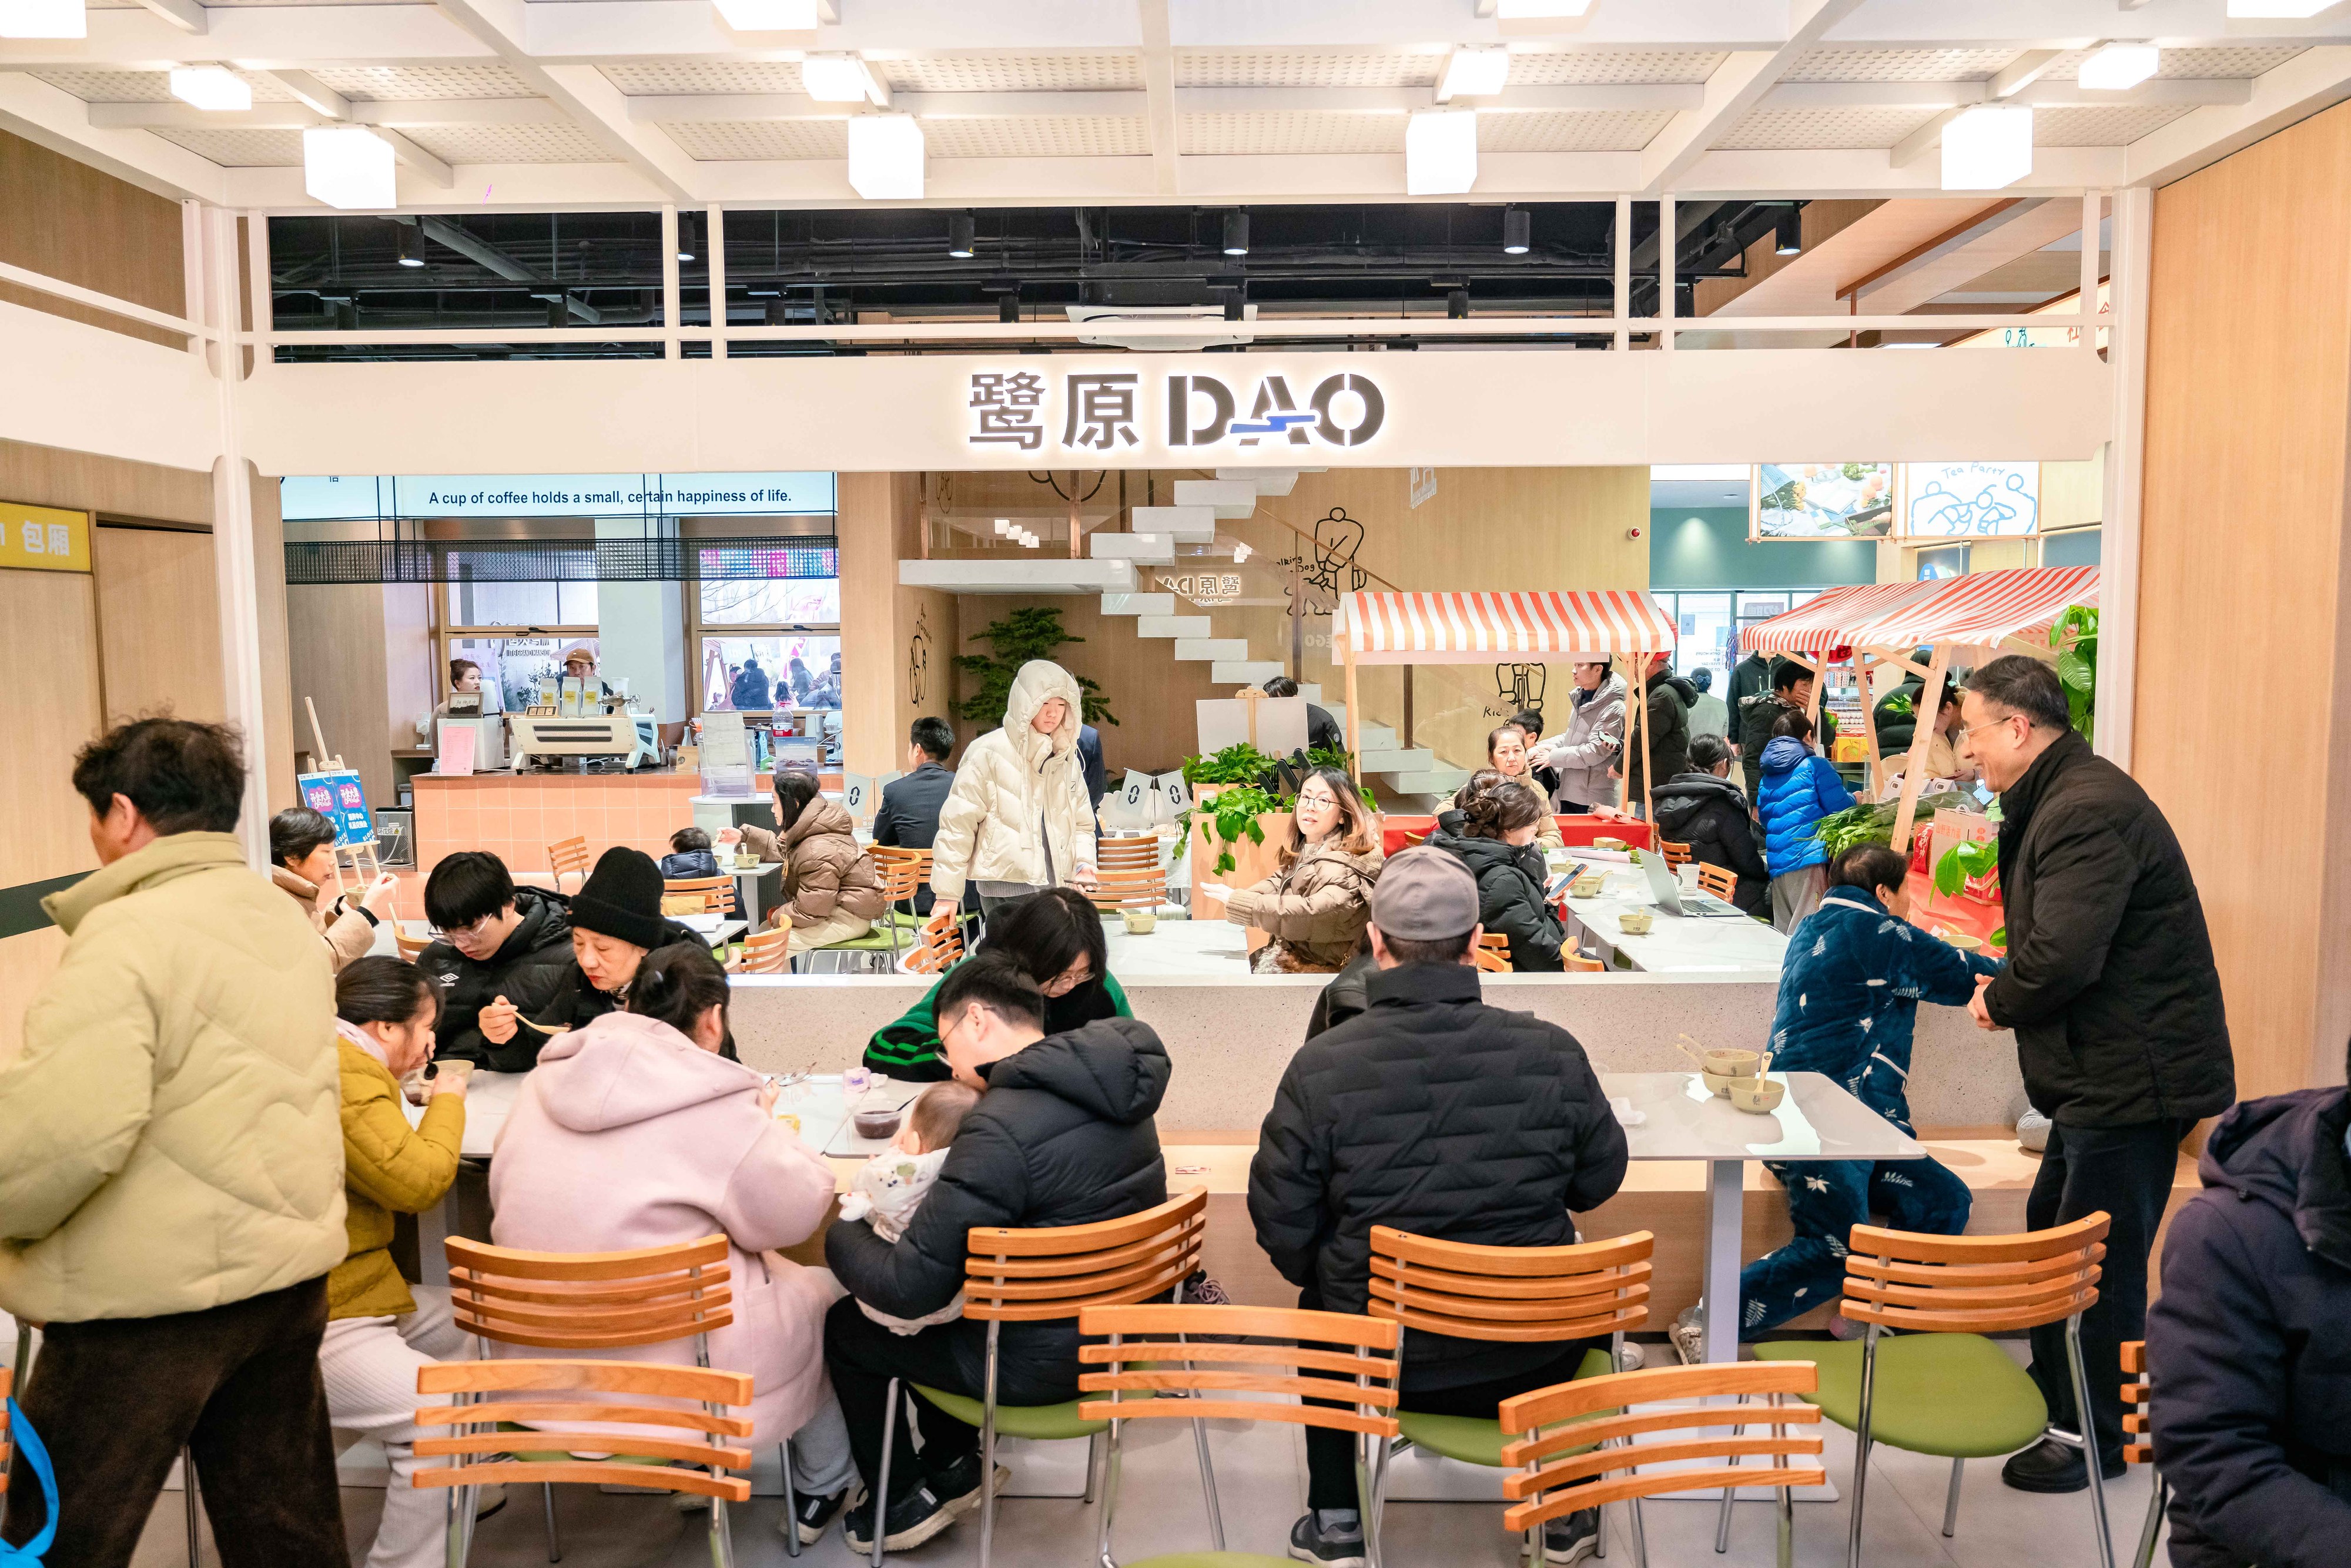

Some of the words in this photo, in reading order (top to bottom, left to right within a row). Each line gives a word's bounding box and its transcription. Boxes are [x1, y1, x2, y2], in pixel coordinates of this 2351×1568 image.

[969, 371, 1140, 450] 鹭原
[1168, 373, 1385, 446] DAO
[1941, 467, 1964, 479] Tea
[1971, 461, 2005, 475] Party
[429, 492, 439, 504] A
[443, 494, 466, 507] cup
[471, 492, 484, 504] of
[488, 491, 528, 504] coffee
[533, 491, 568, 504] holds
[573, 494, 580, 503] a
[584, 491, 623, 504] small,
[628, 490, 673, 502] certain
[677, 490, 746, 504] happiness
[751, 490, 764, 501] of
[768, 489, 791, 501] life.
[21, 521, 70, 556] 包厢
[1297, 564, 1315, 572] Dog
